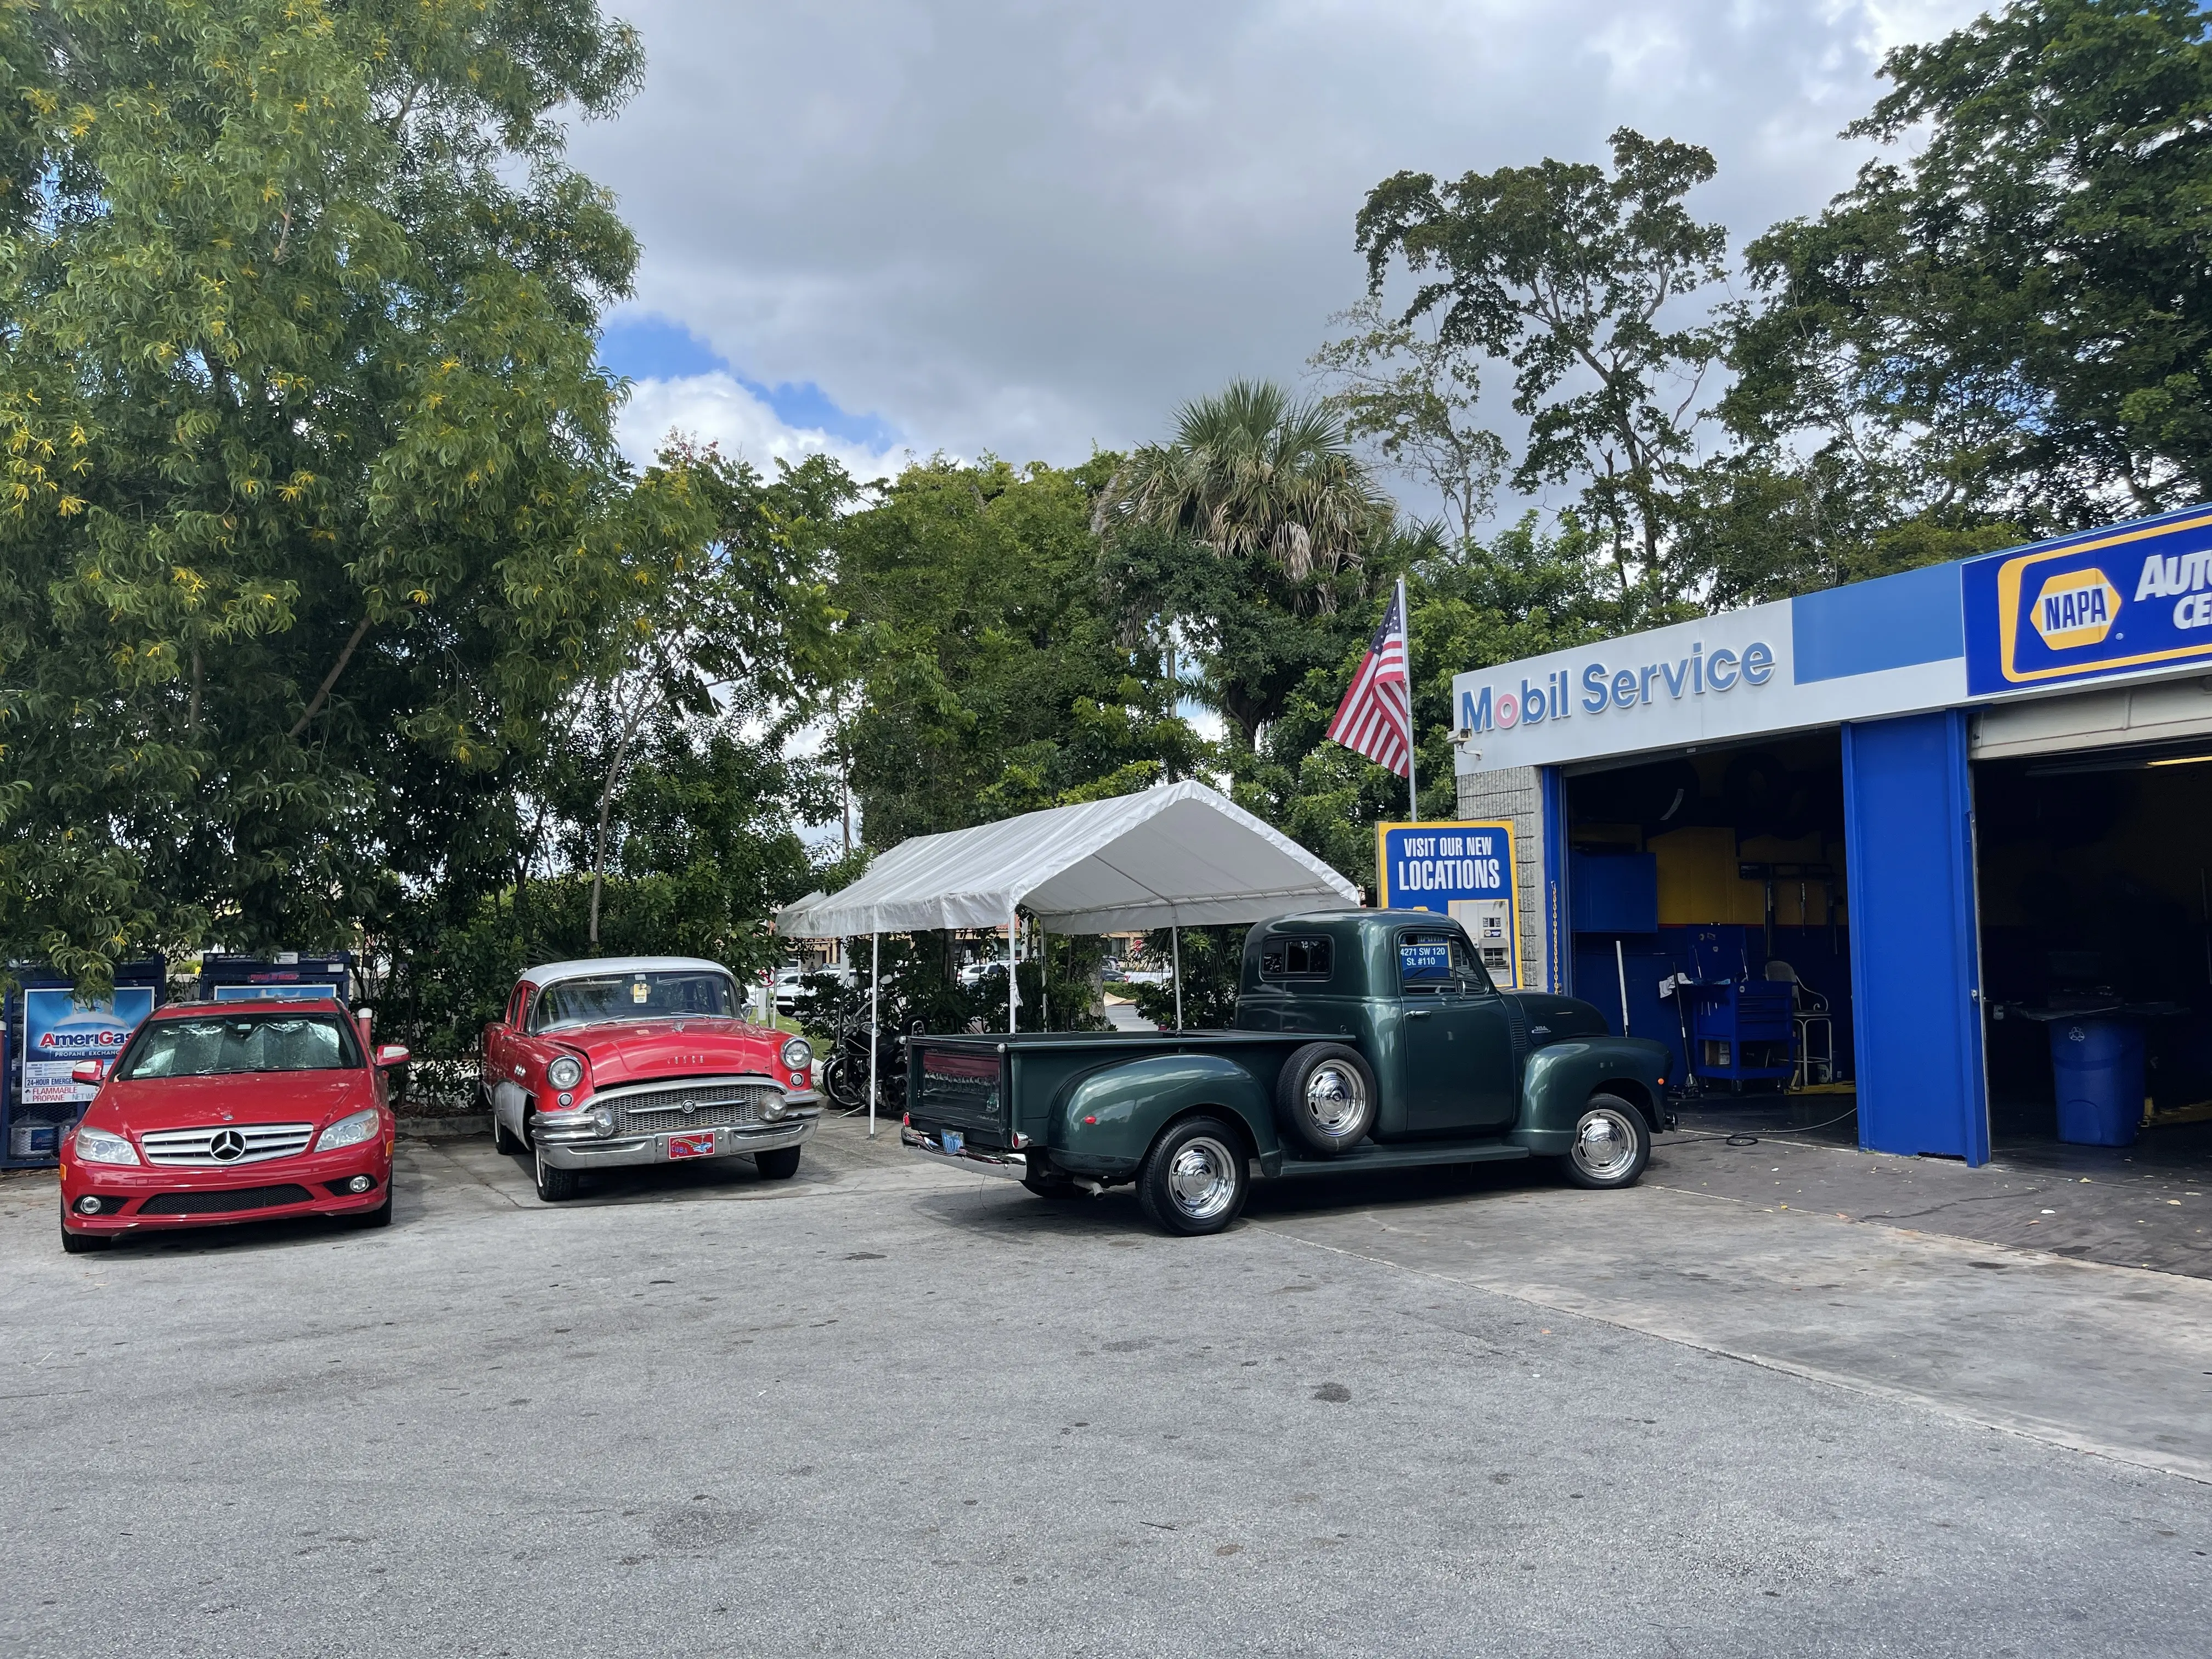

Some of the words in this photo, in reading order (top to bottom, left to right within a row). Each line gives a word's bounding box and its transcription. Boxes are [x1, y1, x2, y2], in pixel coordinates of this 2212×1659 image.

[2134, 549, 2212, 602] AUT
[2045, 588, 2107, 631] NAPA
[2172, 592, 2212, 630] CE
[1462, 669, 1571, 733] Mobil
[1582, 641, 1775, 714] Service
[1403, 837, 1436, 857] VISIT
[1440, 837, 1463, 856] OUR
[1466, 837, 1492, 856] NEW
[1398, 859, 1500, 891] LOCATIONS
[1432, 947, 1446, 955] 120
[1406, 957, 1416, 966] St.
[1418, 957, 1435, 965] #110
[32, 1086, 77, 1095] FLAMMABLE
[32, 1094, 65, 1102] PROPANE
[671, 1145, 687, 1155] CUBA
